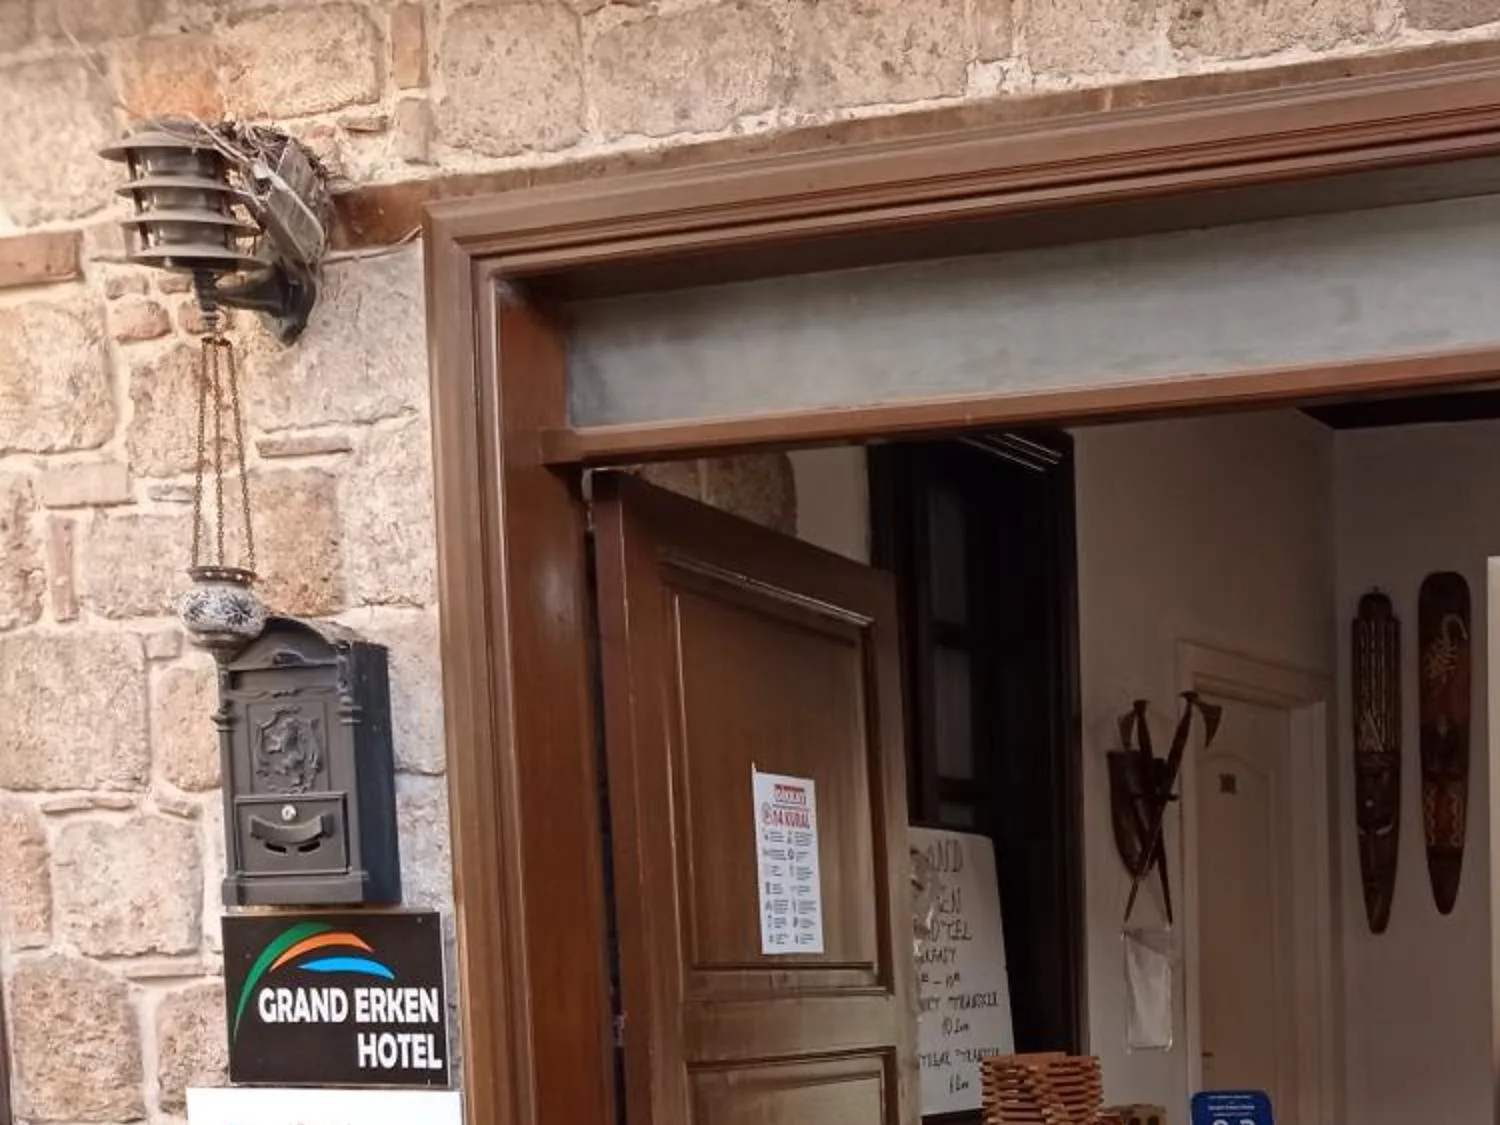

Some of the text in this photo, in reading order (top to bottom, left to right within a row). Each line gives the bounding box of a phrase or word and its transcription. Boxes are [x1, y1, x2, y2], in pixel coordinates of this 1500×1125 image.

[258, 987, 439, 1024] GRAND ERKEN
[358, 1033, 443, 1070] HOTEL
